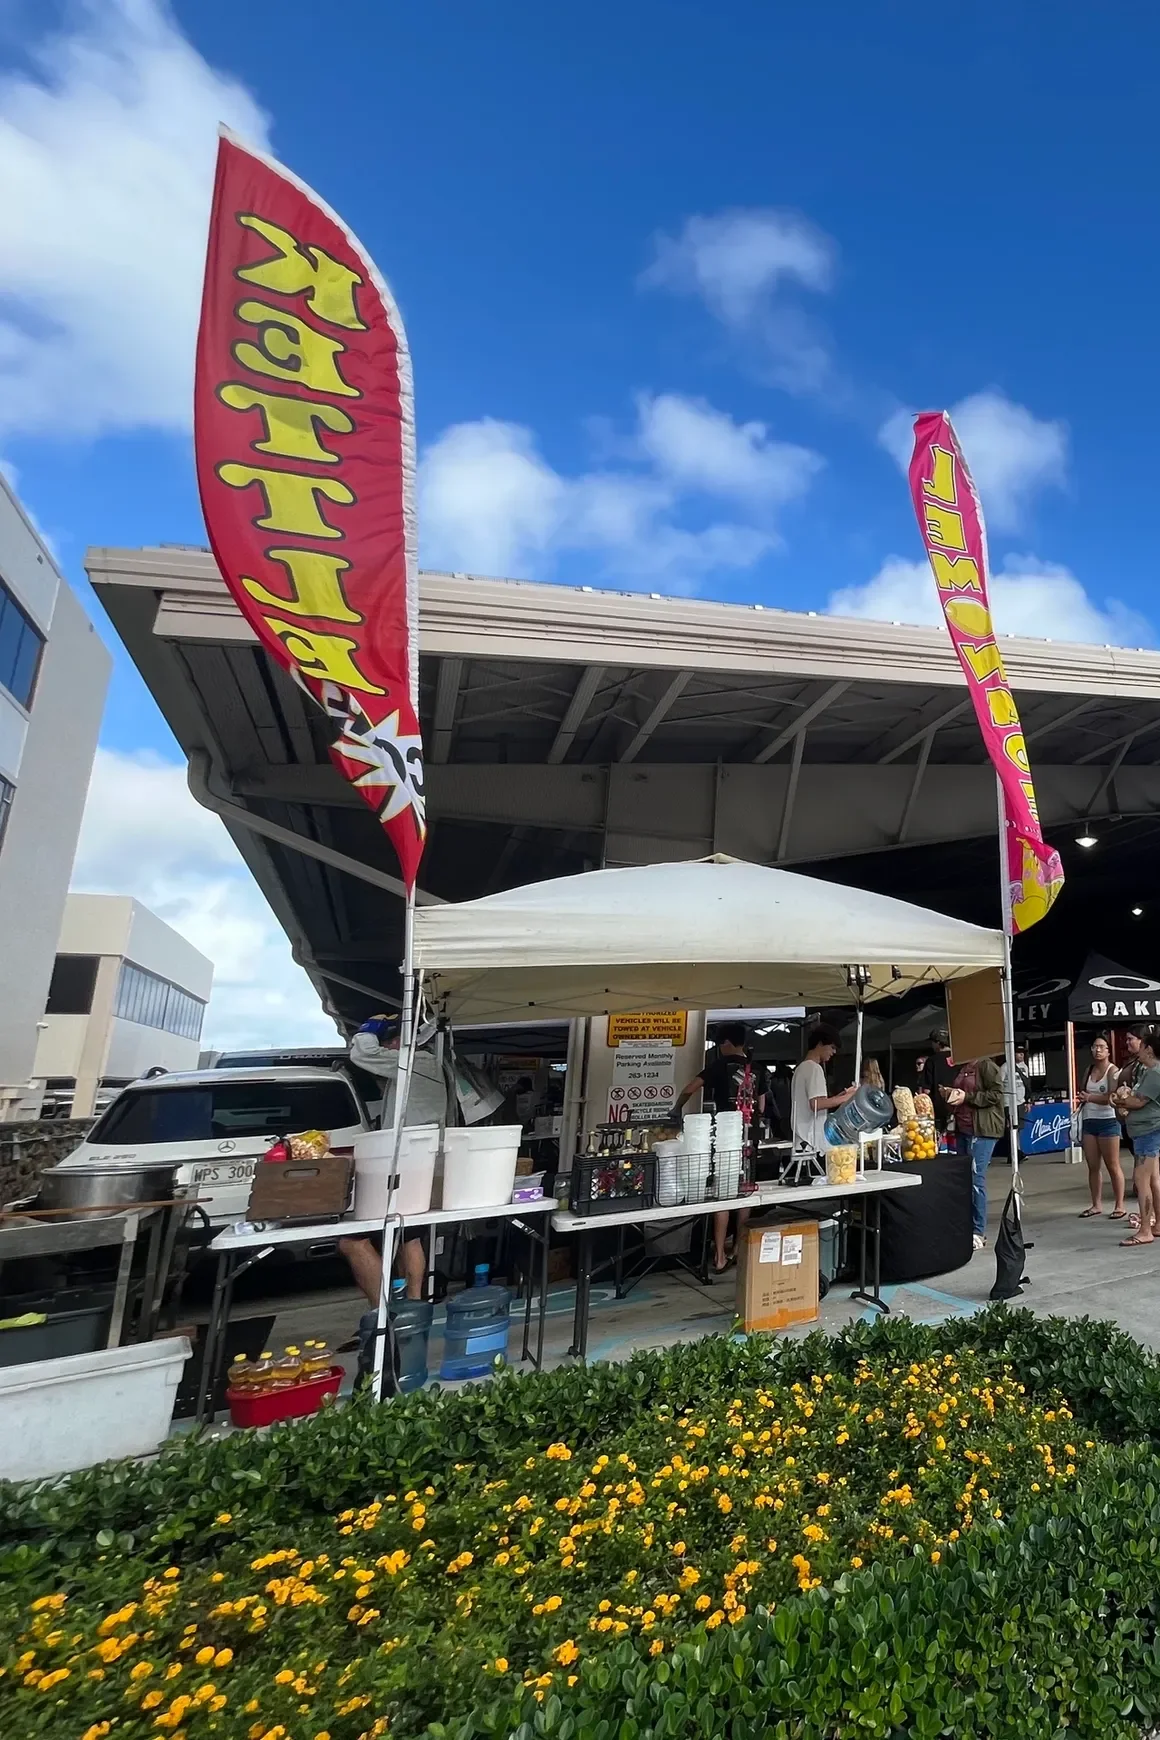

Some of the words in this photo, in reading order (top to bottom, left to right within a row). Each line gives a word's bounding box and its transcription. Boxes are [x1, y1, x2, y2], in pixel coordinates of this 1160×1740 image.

[1016, 1003, 1052, 1022] LEY
[608, 1103, 630, 1124] NO
[228, 1164, 253, 1179] 300
